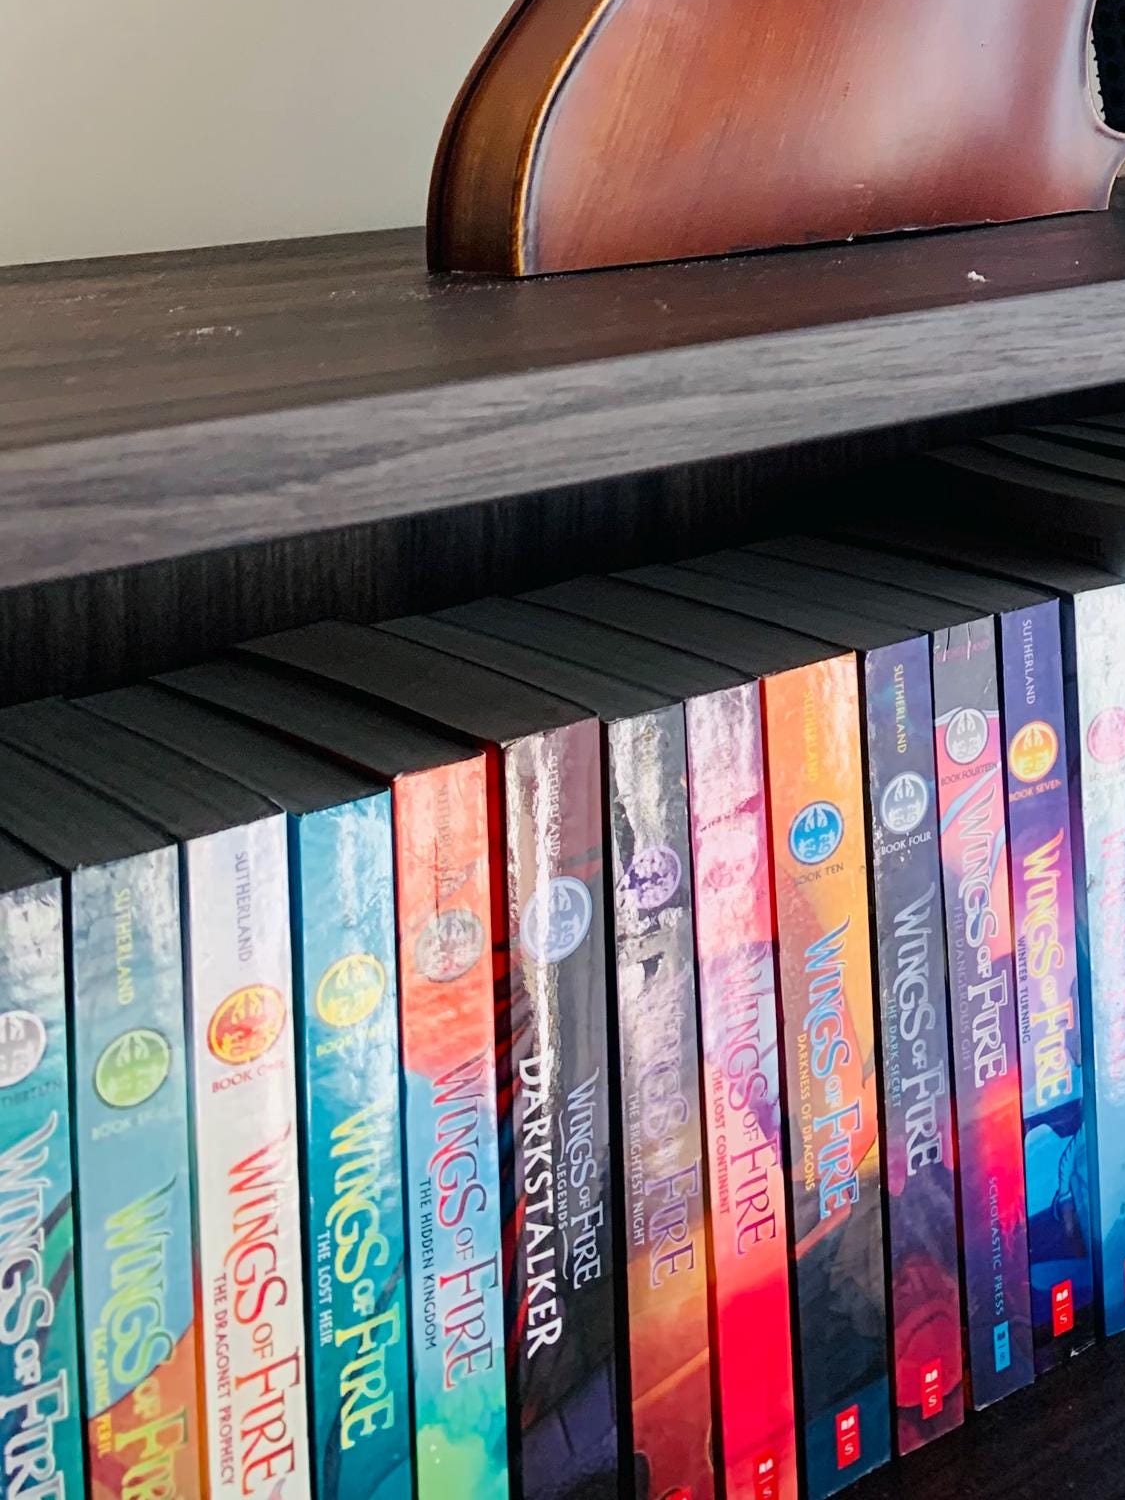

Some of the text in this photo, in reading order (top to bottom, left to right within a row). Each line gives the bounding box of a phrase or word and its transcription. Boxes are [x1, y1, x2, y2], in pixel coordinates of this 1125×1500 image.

[893, 663, 909, 755] SUTHERLAND
[1022, 619, 1038, 705] SUTHERLAND
[803, 691, 822, 782] SUTHERLAND
[941, 763, 998, 787] BOOK FOURTEEN
[1009, 778, 1062, 803] BOOK SEVEN
[233, 851, 253, 963] SUTHERLAND
[825, 863, 845, 878] TEN
[881, 831, 932, 855] BOOK FOUR
[115, 887, 136, 1006] SUTHERLAND
[952, 904, 973, 1072] THE DANGEROUS GIFT
[959, 784, 1009, 1089] WINGS OF FIRE
[1017, 935, 1033, 1046] WINTER TURNING
[1022, 827, 1075, 1108] WINGS OF FIRE
[211, 1067, 253, 1094] BOOK
[803, 914, 864, 1221] WINGS OF FIRE
[887, 998, 903, 1109] THE DARK SECRET
[892, 881, 946, 1177] WINGS OF FIRE
[628, 1091, 646, 1247] THE BRIGHTEST NIGHT
[711, 1067, 733, 1215] THE LOST CONTINENT
[725, 946, 780, 1256] WINGS OF FIRE
[796, 1032, 817, 1193] DARKNESS OF DRAGONS
[0, 1109, 58, 1345] WINGS
[428, 1043, 500, 1389] WINGS OF FIRE
[519, 1054, 562, 1360] DARKSTALKER
[556, 1161, 569, 1232] LEGENDS
[565, 1066, 605, 1291] WINGS OF FIRE
[644, 1159, 700, 1289] FIRE
[987, 1175, 1005, 1316] SCHOLASTIC PRESS
[99, 1175, 178, 1385] WINGS
[223, 1120, 302, 1496] WINGS OF FIRE
[316, 1230, 334, 1348] THE LOST HEIR
[325, 1092, 401, 1451] WINGS OF FIRE
[419, 1177, 440, 1351] THE HIDDEN KINGDOM
[14, 1339, 41, 1386] OF
[132, 1375, 161, 1420] OF
[213, 1273, 235, 1485] THE DRAGONET PROPHECY
[96, 1413, 113, 1458] PERIL
